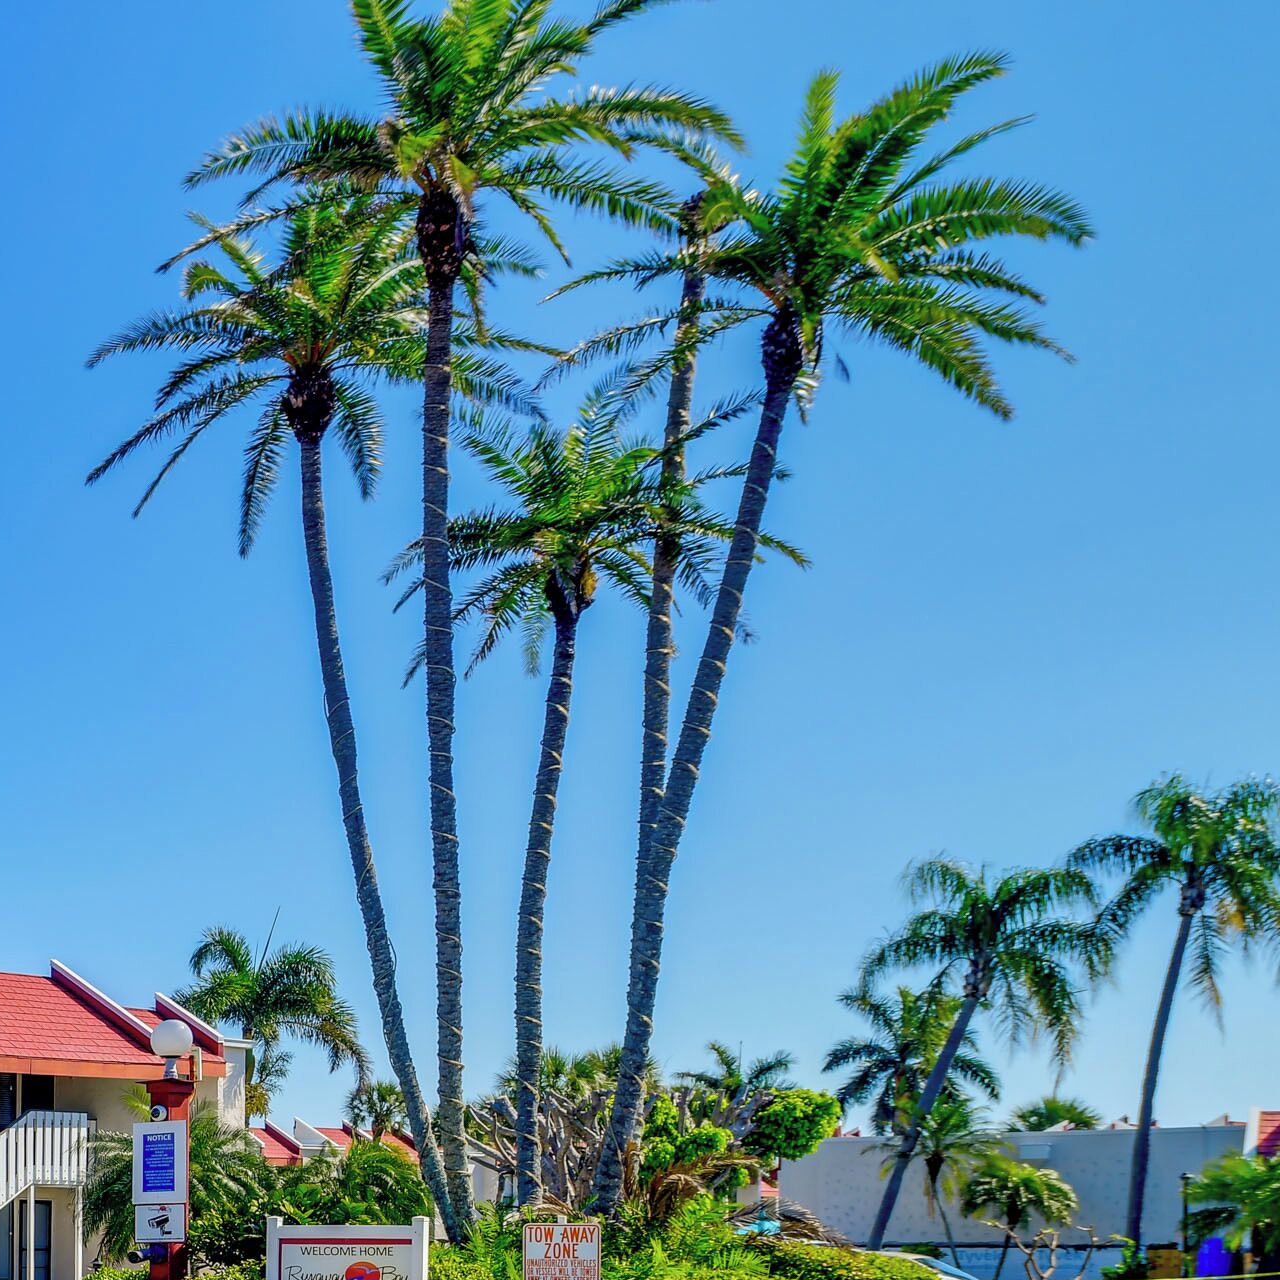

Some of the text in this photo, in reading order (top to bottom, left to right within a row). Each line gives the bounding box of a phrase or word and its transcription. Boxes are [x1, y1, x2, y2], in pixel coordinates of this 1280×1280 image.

[147, 1133, 172, 1142] NOTICE
[527, 1226, 596, 1243] TOW AWAY
[300, 1246, 394, 1257] WELCOME HOME
[544, 1243, 579, 1259] ZONE
[527, 1259, 596, 1268] UNAUTHORIZED VEHICLES
[527, 1267, 596, 1276] OR VESSELS WILL BE TOWED
